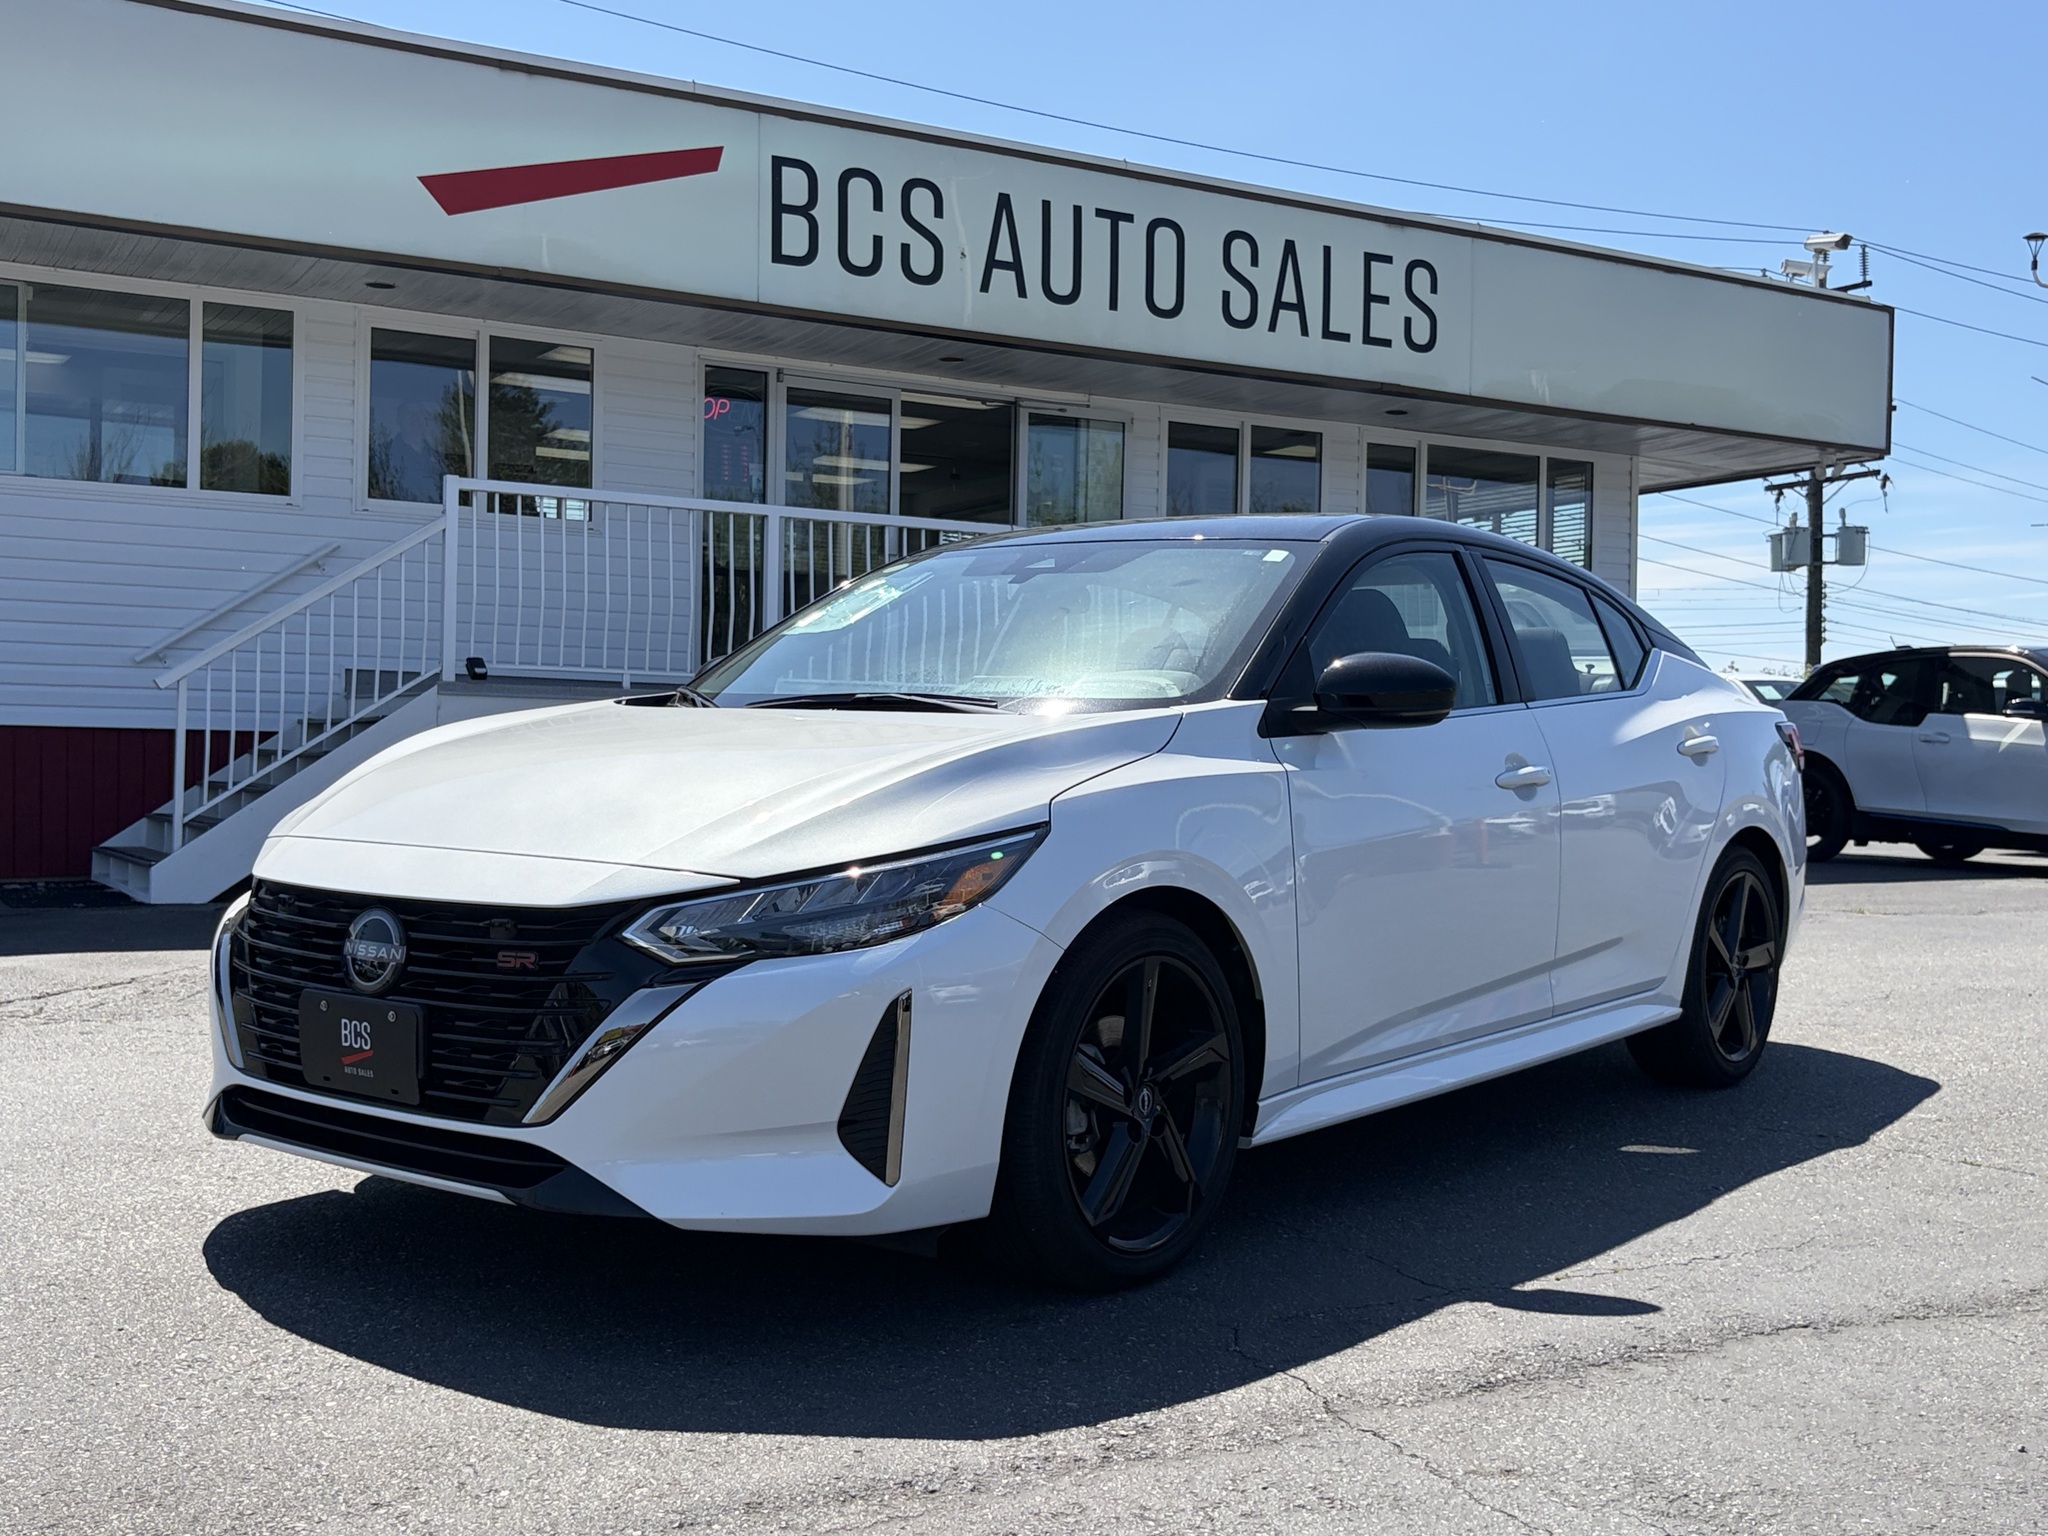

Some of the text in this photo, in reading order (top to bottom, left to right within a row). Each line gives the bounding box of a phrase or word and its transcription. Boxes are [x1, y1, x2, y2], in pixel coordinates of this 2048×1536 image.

[771, 155, 1438, 353] BCS AUTO SALES
[345, 941, 402, 960] NISSAN
[497, 951, 536, 969] SR
[341, 1018, 371, 1050] BCS
